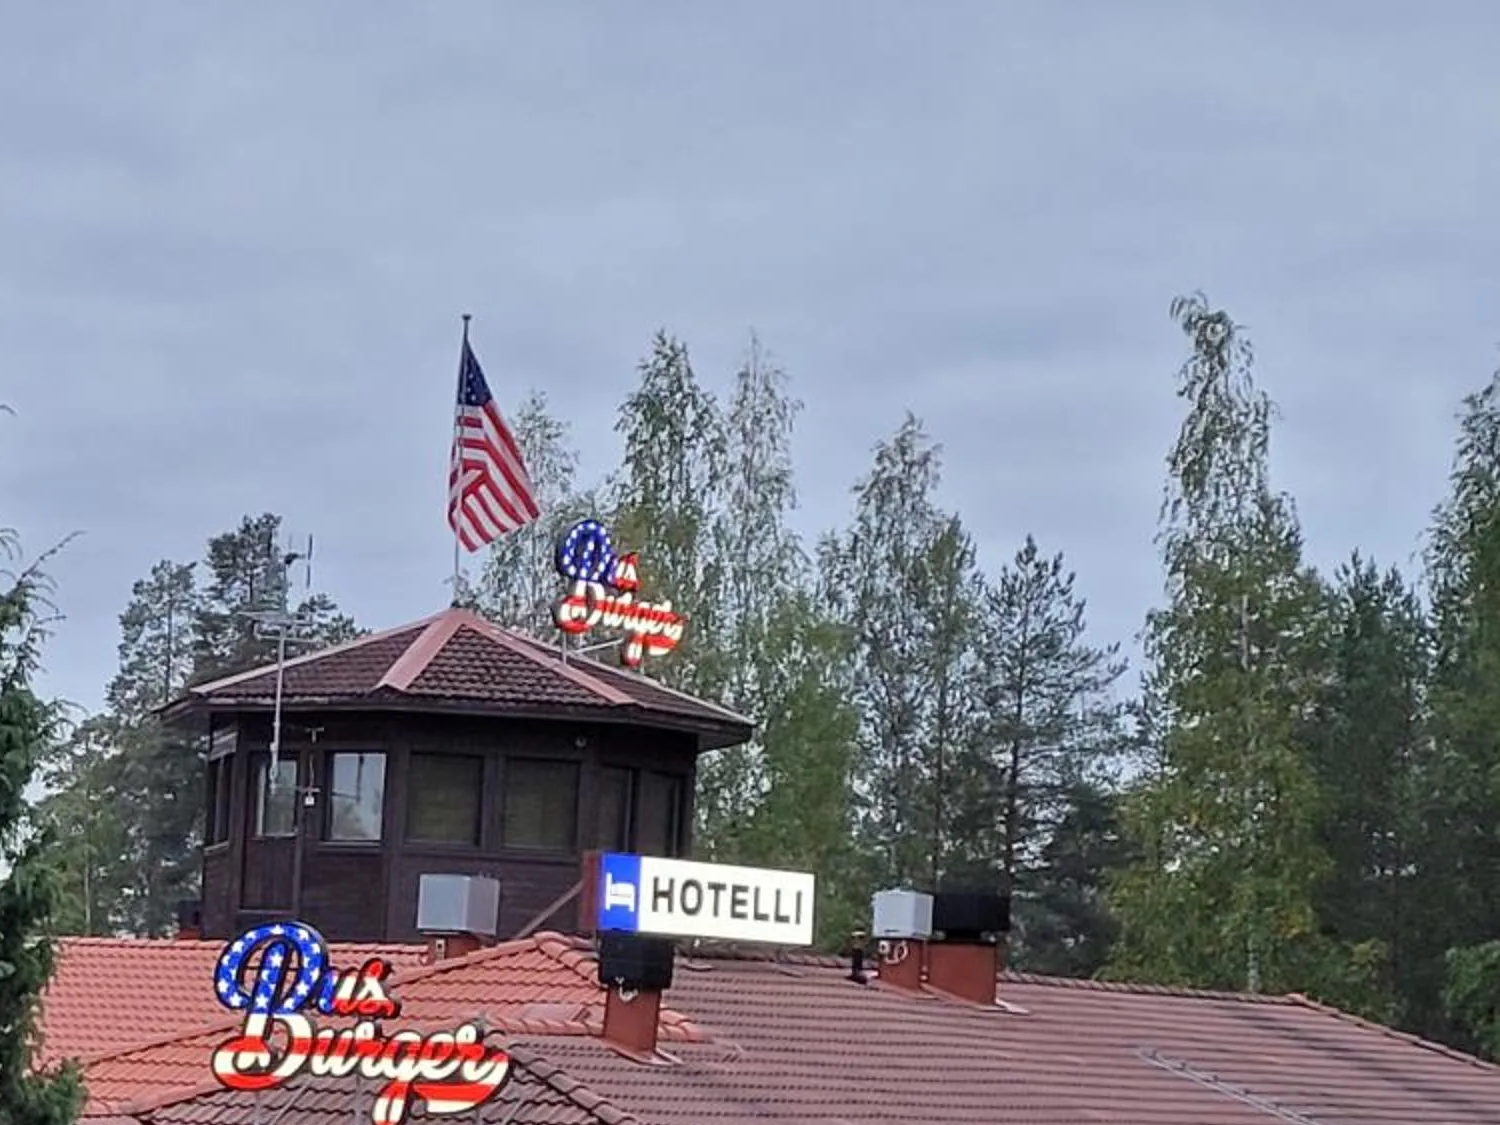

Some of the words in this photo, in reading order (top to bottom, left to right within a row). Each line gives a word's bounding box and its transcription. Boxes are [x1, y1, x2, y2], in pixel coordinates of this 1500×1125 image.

[552, 581, 687, 668] Burger
[652, 876, 803, 925] HOTELLI
[214, 921, 402, 1017] Bus
